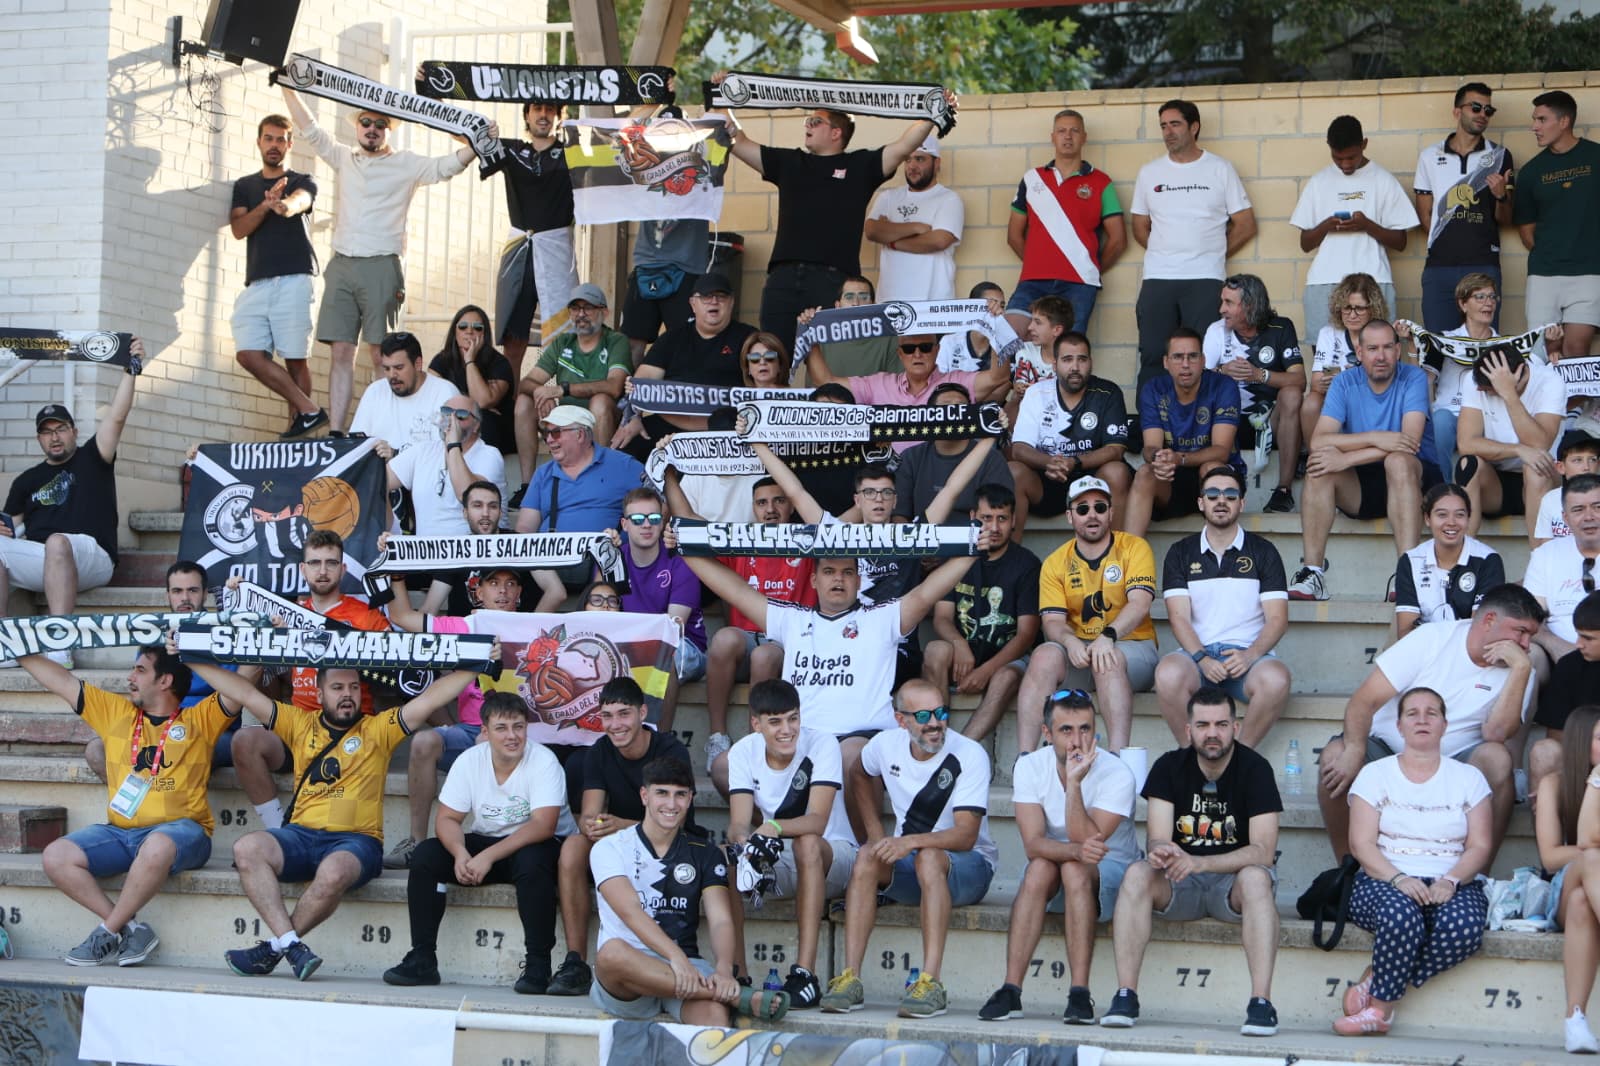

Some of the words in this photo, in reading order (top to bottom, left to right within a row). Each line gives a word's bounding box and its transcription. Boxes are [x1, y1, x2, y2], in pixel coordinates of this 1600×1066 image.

[471, 65, 620, 103] UNIONISTAS
[322, 72, 381, 103] UNIONISTAS
[384, 92, 397, 108] DE
[399, 94, 461, 126] SALAMANCA
[462, 113, 477, 129] CF
[757, 84, 819, 104] UNIONISTAS
[823, 91, 836, 104] DE
[838, 92, 900, 109] SALAMANCA
[903, 93, 917, 109] CF
[1160, 182, 1211, 193] Champion
[964, 304, 978, 313] PER
[830, 317, 883, 342] GATOS
[0, 336, 71, 350] ONISTAS
[1556, 364, 1600, 384] UNIONIS
[630, 383, 706, 405] IONISTAS
[707, 387, 730, 406] DE
[731, 389, 810, 406] SALAMAN
[768, 406, 846, 426] UNIONISTAS
[846, 407, 865, 425] de
[866, 406, 944, 424] Salamanca
[946, 404, 972, 422] C.F.
[671, 437, 741, 458] UNIONISTAS
[768, 443, 831, 456] alamanca
[1060, 442, 1076, 451] Don
[1078, 439, 1093, 450] QR
[397, 538, 470, 560] UNIONISTAS
[476, 538, 492, 558] DE
[496, 537, 572, 558] SALAMANCA
[764, 580, 784, 590] Don
[795, 650, 809, 668] La
[791, 669, 809, 687] del
[809, 669, 854, 687] Barrio
[555, 705, 580, 719] GRADA
[579, 697, 594, 710] DEL
[220, 809, 248, 827] 93
[670, 896, 688, 909] QR
[233, 918, 261, 937] 91
[361, 924, 392, 944] 89
[475, 929, 506, 950] 87
[881, 950, 911, 971] 81
[1030, 959, 1065, 980] 79
[1176, 968, 1212, 988] 77
[1484, 988, 1523, 1010] 73
